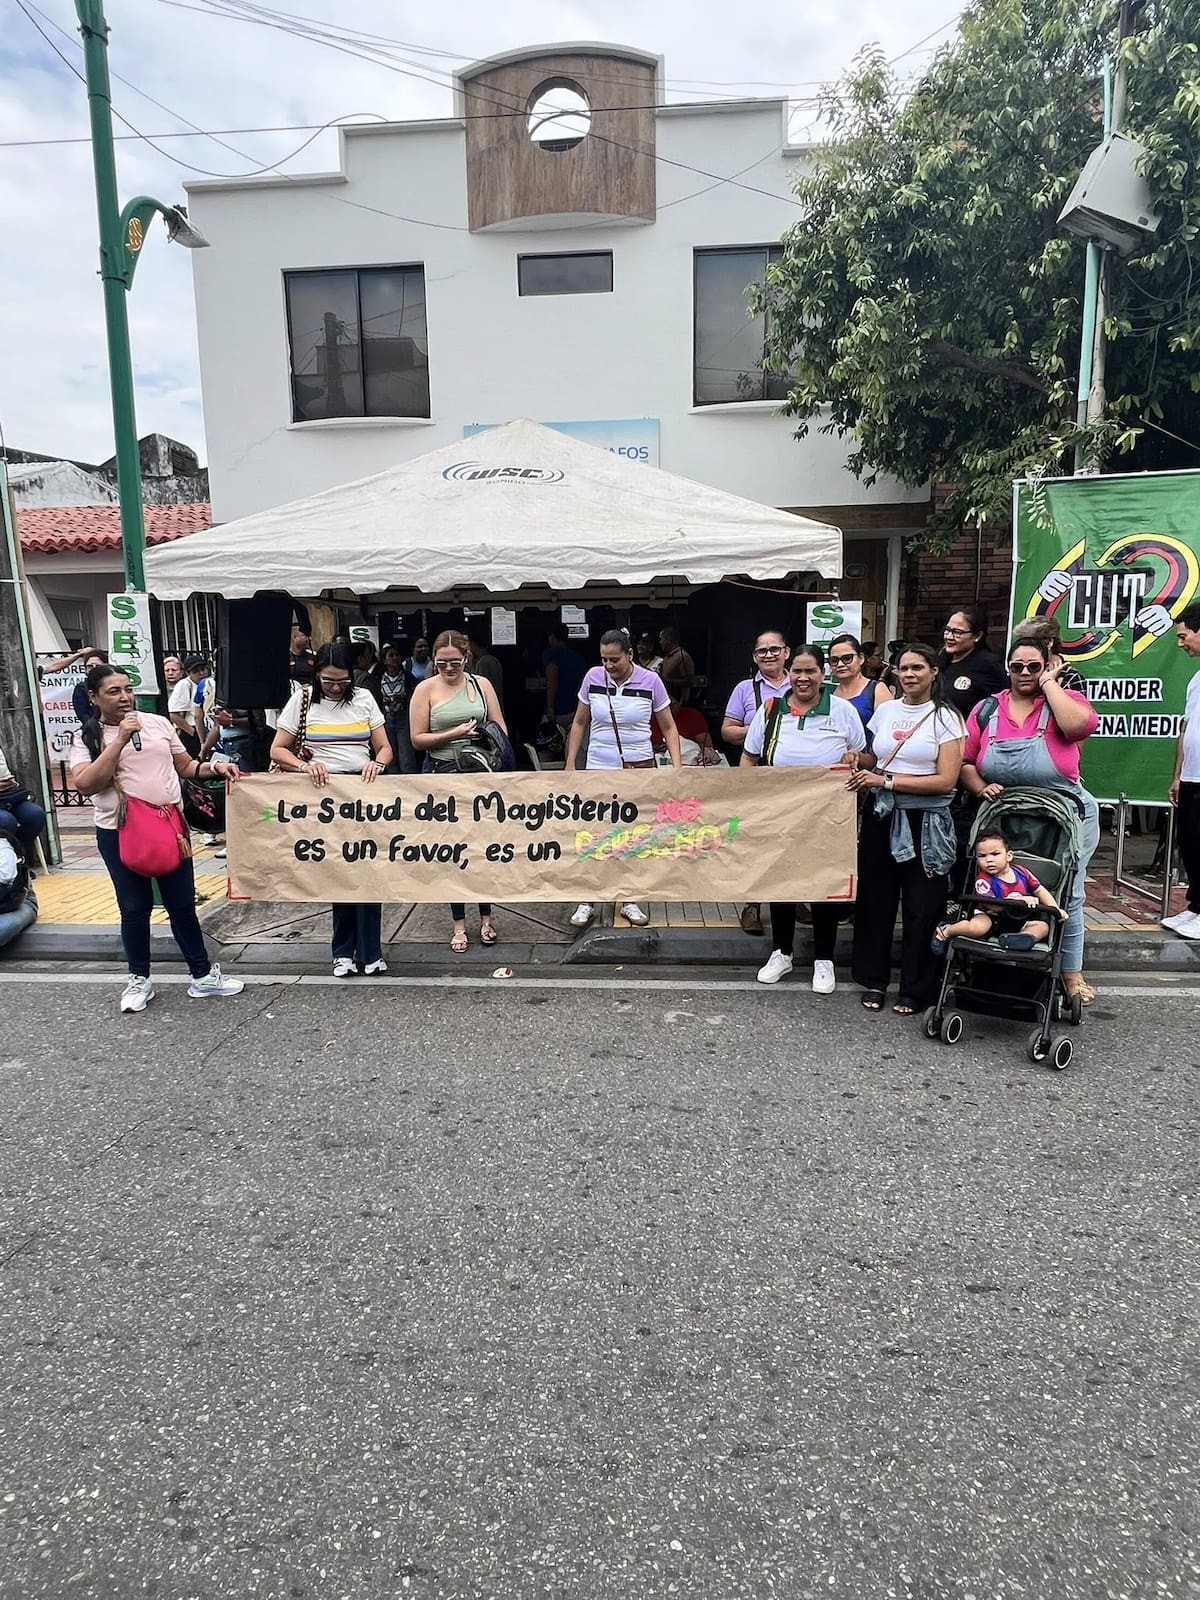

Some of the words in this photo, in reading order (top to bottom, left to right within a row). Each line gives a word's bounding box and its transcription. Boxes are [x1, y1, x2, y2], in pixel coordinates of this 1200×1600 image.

[1068, 573, 1147, 629] CUT
[41, 678, 86, 687] SANTAN
[1085, 680, 1161, 700] TANDER
[1132, 716, 1186, 736] MEDI
[414, 793, 459, 823] del
[294, 838, 326, 862] es
[342, 838, 377, 862] un
[485, 841, 515, 863] es
[526, 840, 561, 862] un
